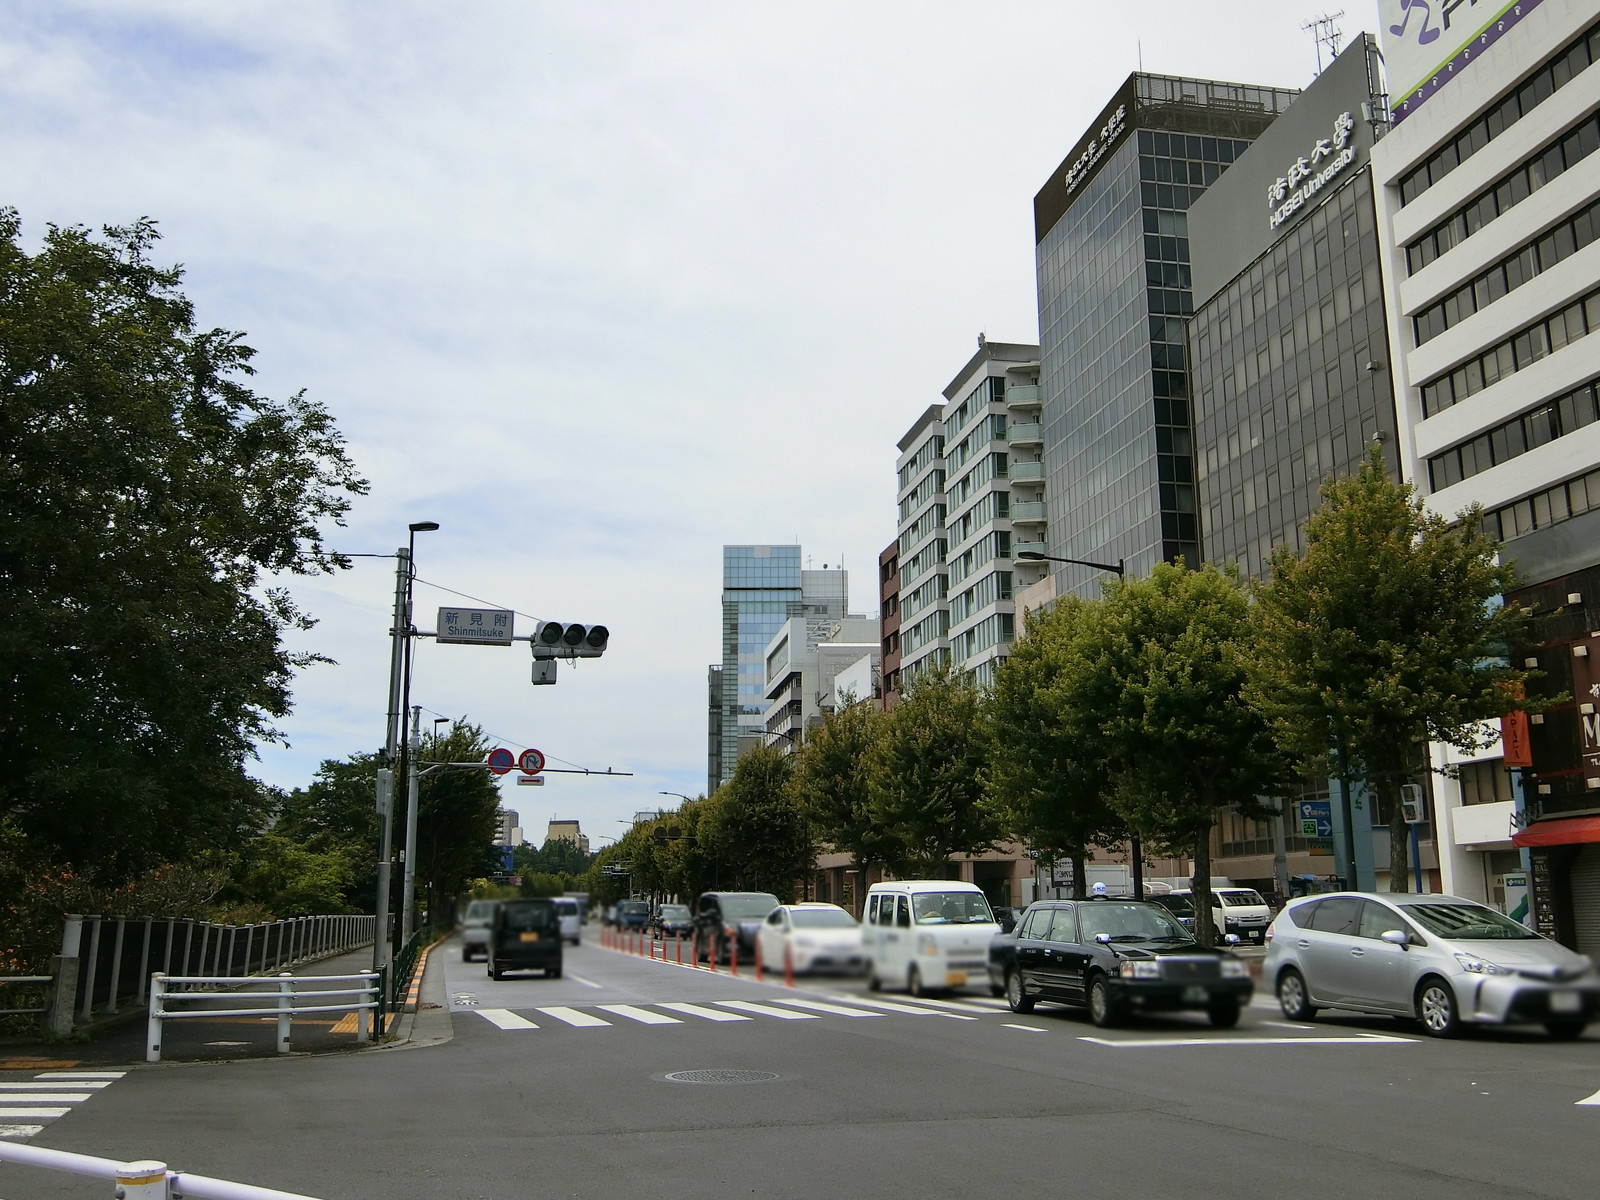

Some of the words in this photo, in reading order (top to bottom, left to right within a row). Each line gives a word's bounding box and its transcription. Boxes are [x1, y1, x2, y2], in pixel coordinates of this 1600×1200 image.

[1269, 189, 1305, 230] HOSEI
[1303, 145, 1356, 199] University
[445, 612, 508, 627] 新見附
[448, 626, 504, 638] Shinmitsuke
